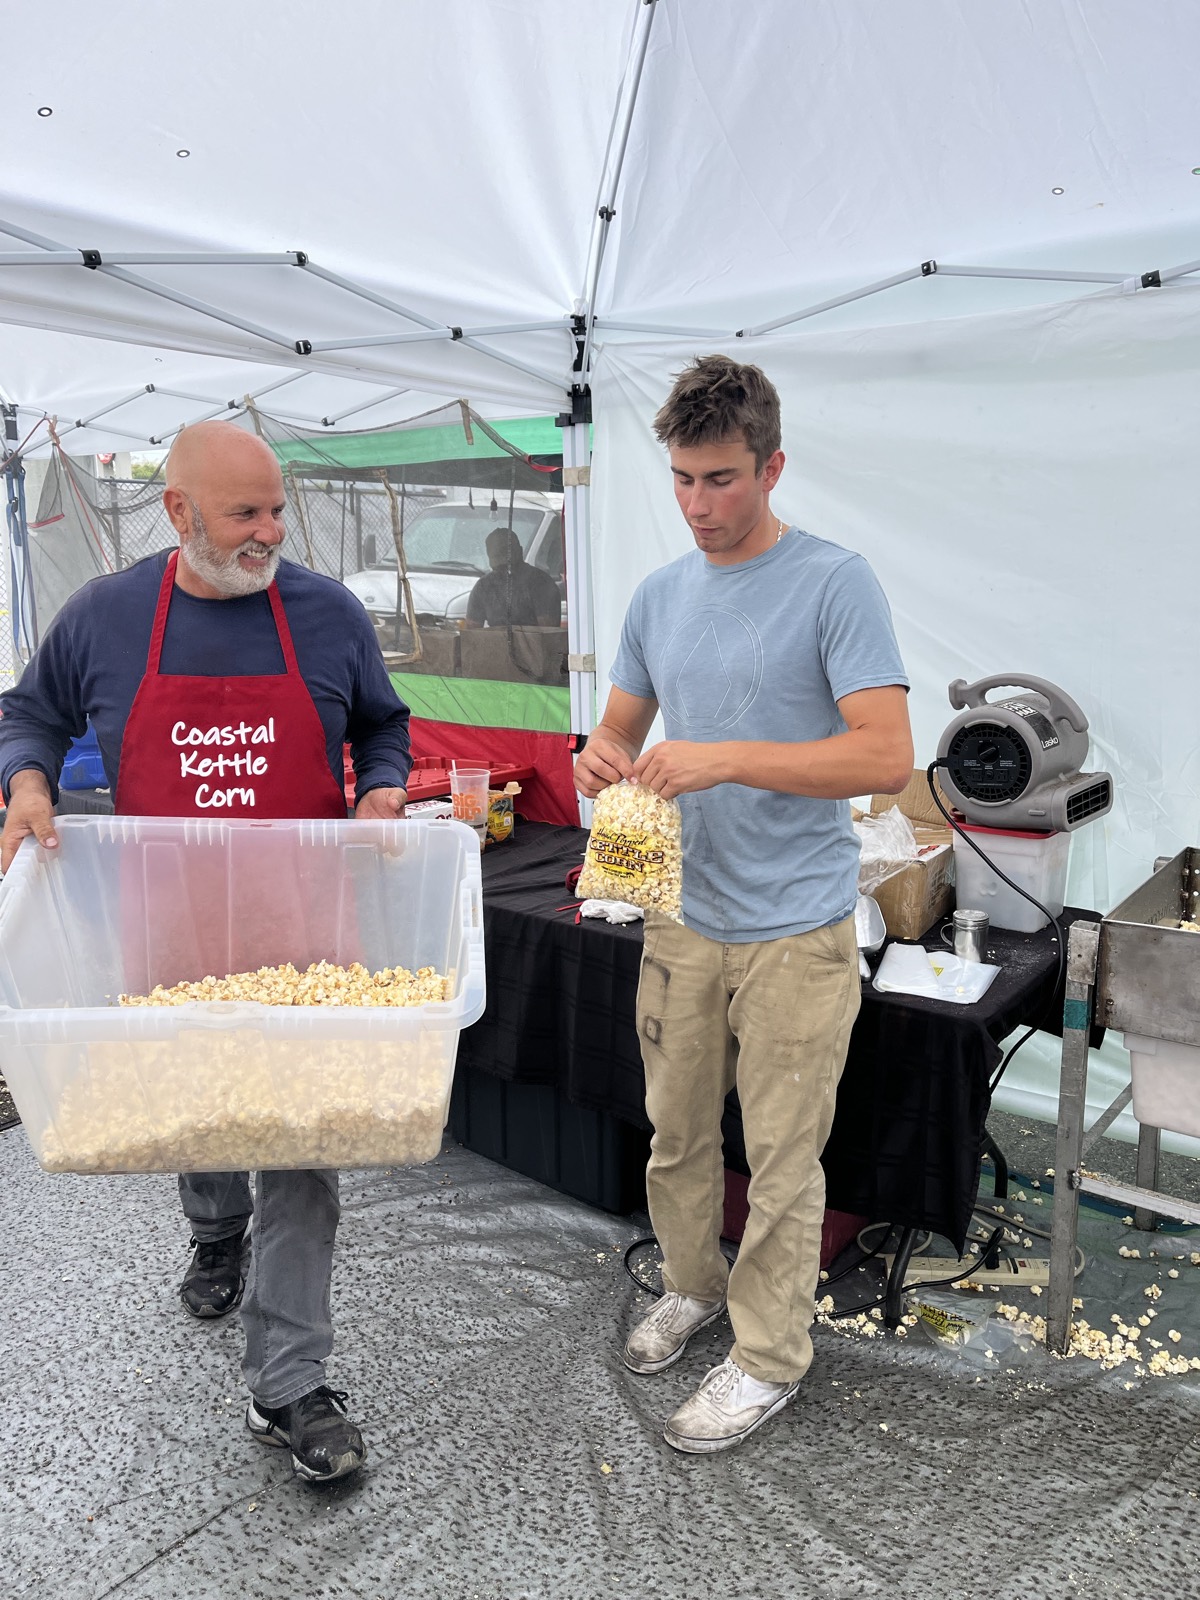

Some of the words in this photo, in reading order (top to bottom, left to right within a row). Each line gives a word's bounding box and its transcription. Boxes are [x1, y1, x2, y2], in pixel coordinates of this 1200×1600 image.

[171, 717, 275, 746] Coastal
[1041, 737, 1059, 749] Lasko
[180, 750, 268, 778] Kettle
[195, 783, 255, 808] Corn
[595, 852, 645, 873] CORN
